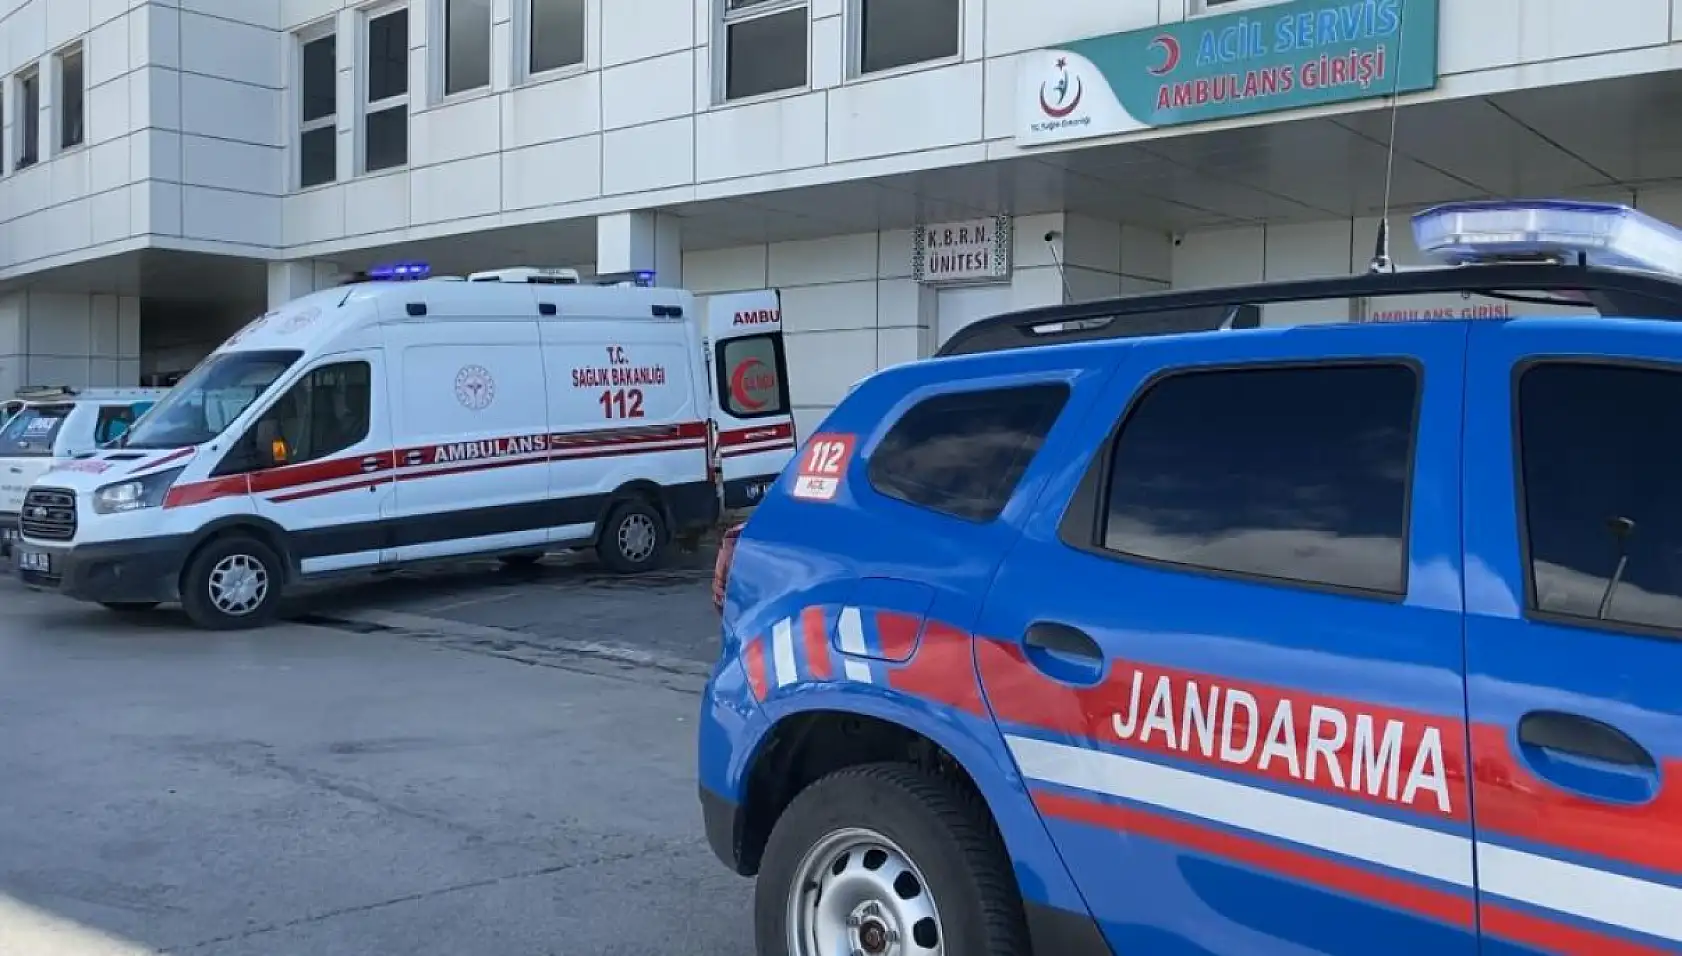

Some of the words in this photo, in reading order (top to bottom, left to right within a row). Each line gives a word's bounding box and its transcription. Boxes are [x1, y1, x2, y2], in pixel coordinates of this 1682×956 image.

[1157, 64, 1295, 110] AMBULANS
[1301, 43, 1387, 89] GİRİŞİ
[927, 224, 991, 248] K.B.R.N.
[733, 309, 780, 325] AMBU
[606, 345, 629, 364] T.C.
[572, 365, 610, 387] SAĞLIK
[611, 362, 665, 386] BAKANLIĞI
[599, 388, 645, 419] 112
[434, 435, 547, 464] AMBULANS
[807, 441, 846, 473] 112
[1111, 669, 1452, 814] JANDARMA
